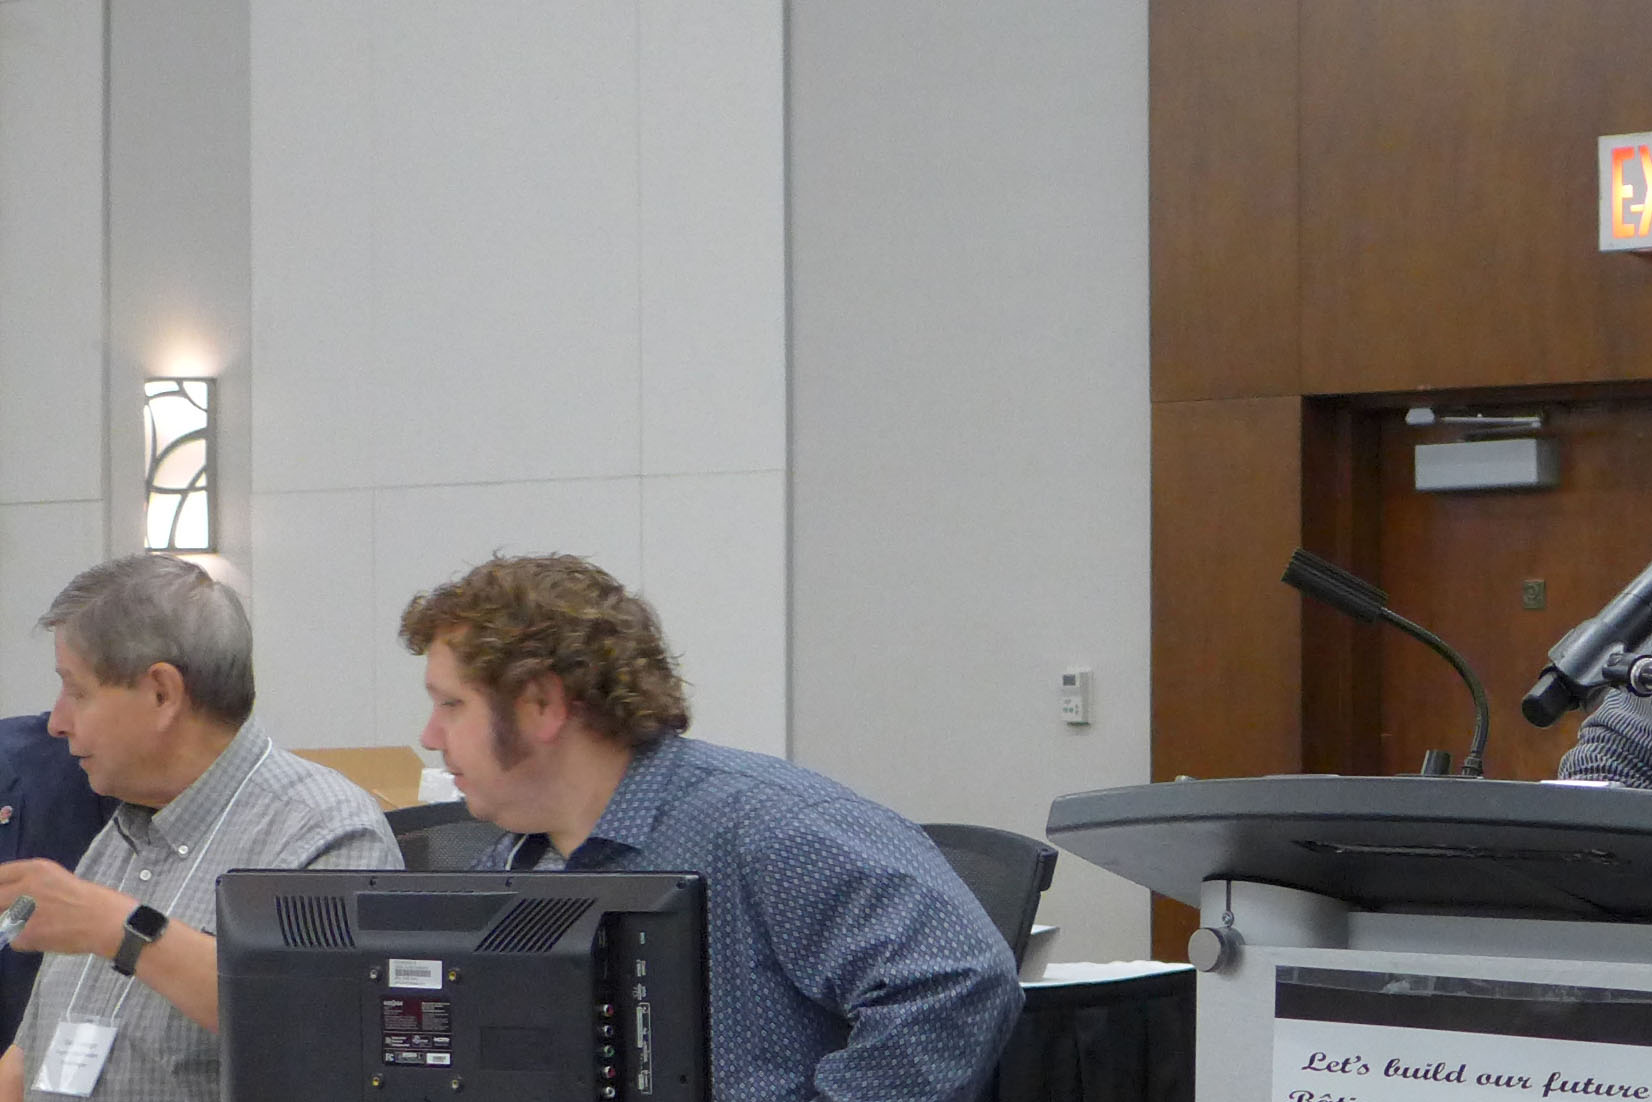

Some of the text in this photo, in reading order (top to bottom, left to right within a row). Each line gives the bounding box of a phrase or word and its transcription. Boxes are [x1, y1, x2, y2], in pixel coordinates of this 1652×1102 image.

[1302, 1051, 1370, 1076] Let's
[1384, 1058, 1467, 1084] build
[1476, 1071, 1533, 1090] our
[1542, 1071, 1650, 1100] future
